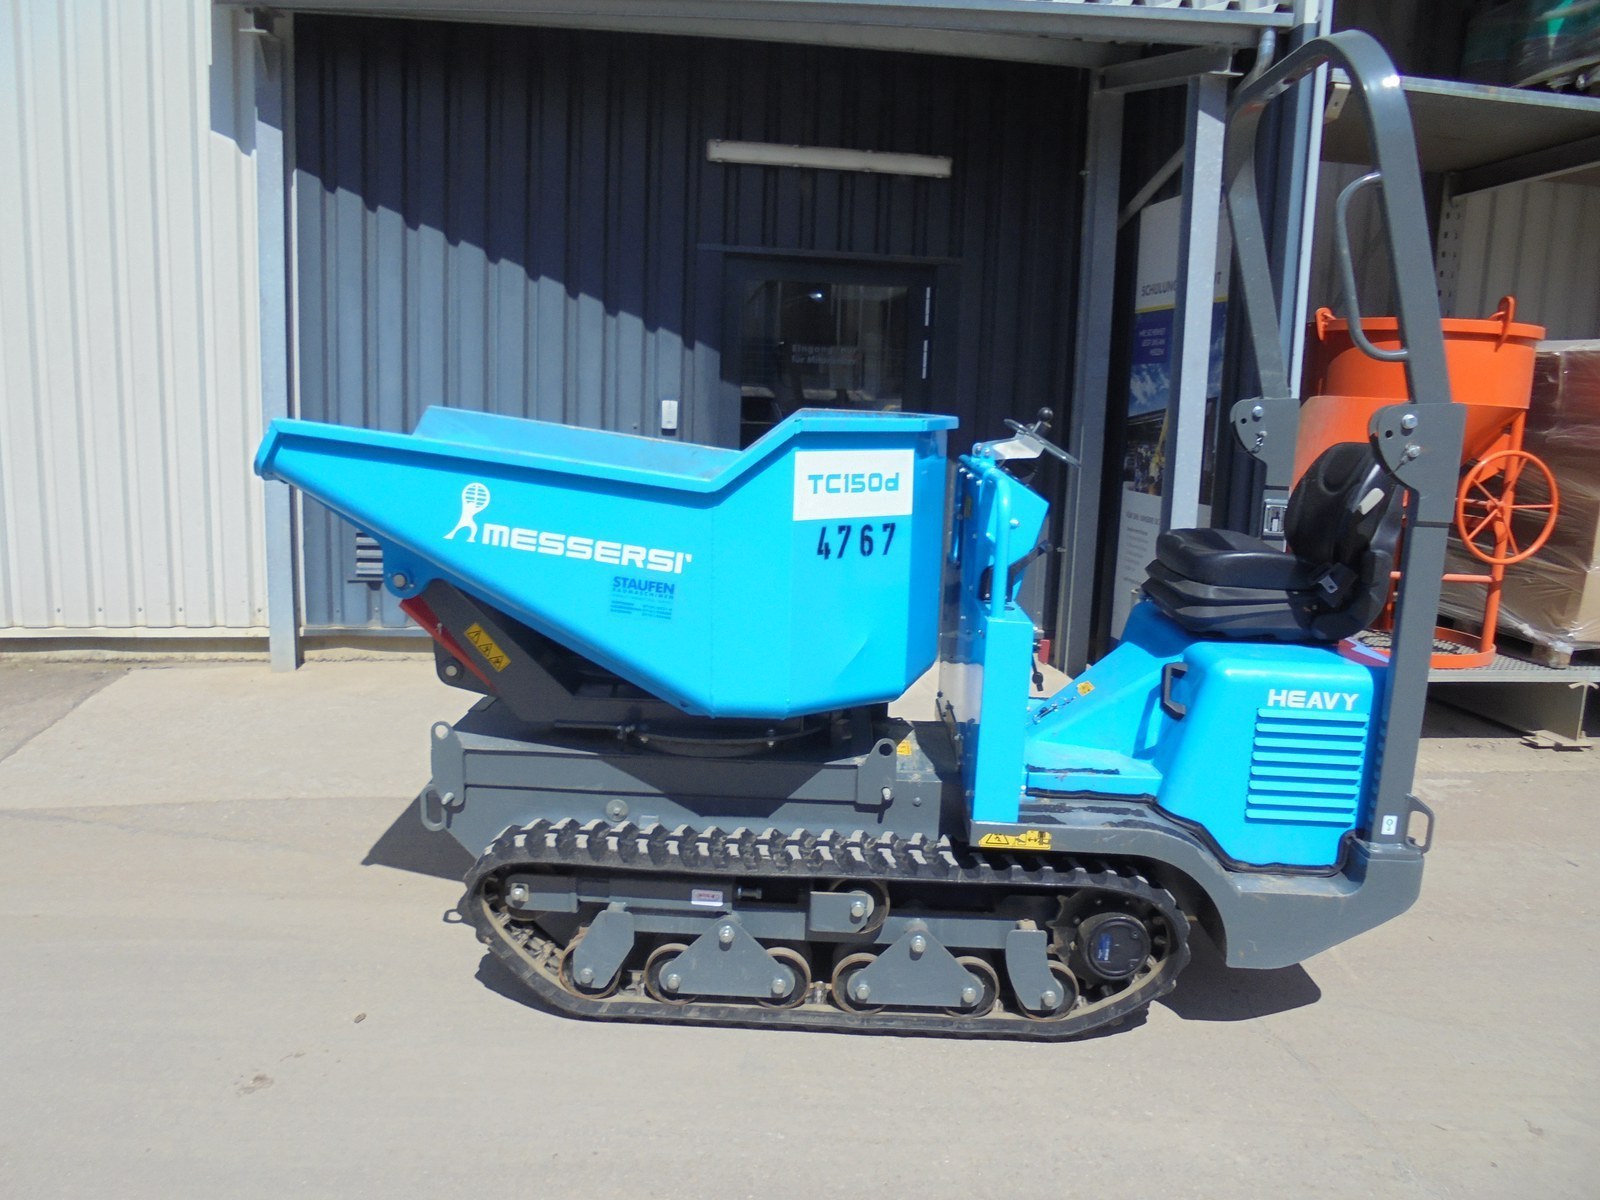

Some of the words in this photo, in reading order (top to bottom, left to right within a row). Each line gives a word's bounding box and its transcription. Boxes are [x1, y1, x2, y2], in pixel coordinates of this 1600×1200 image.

[807, 472, 900, 494] TC150d
[817, 522, 896, 560] 4767
[613, 576, 675, 595] STAUFEN
[1267, 688, 1360, 711] HEAVY
